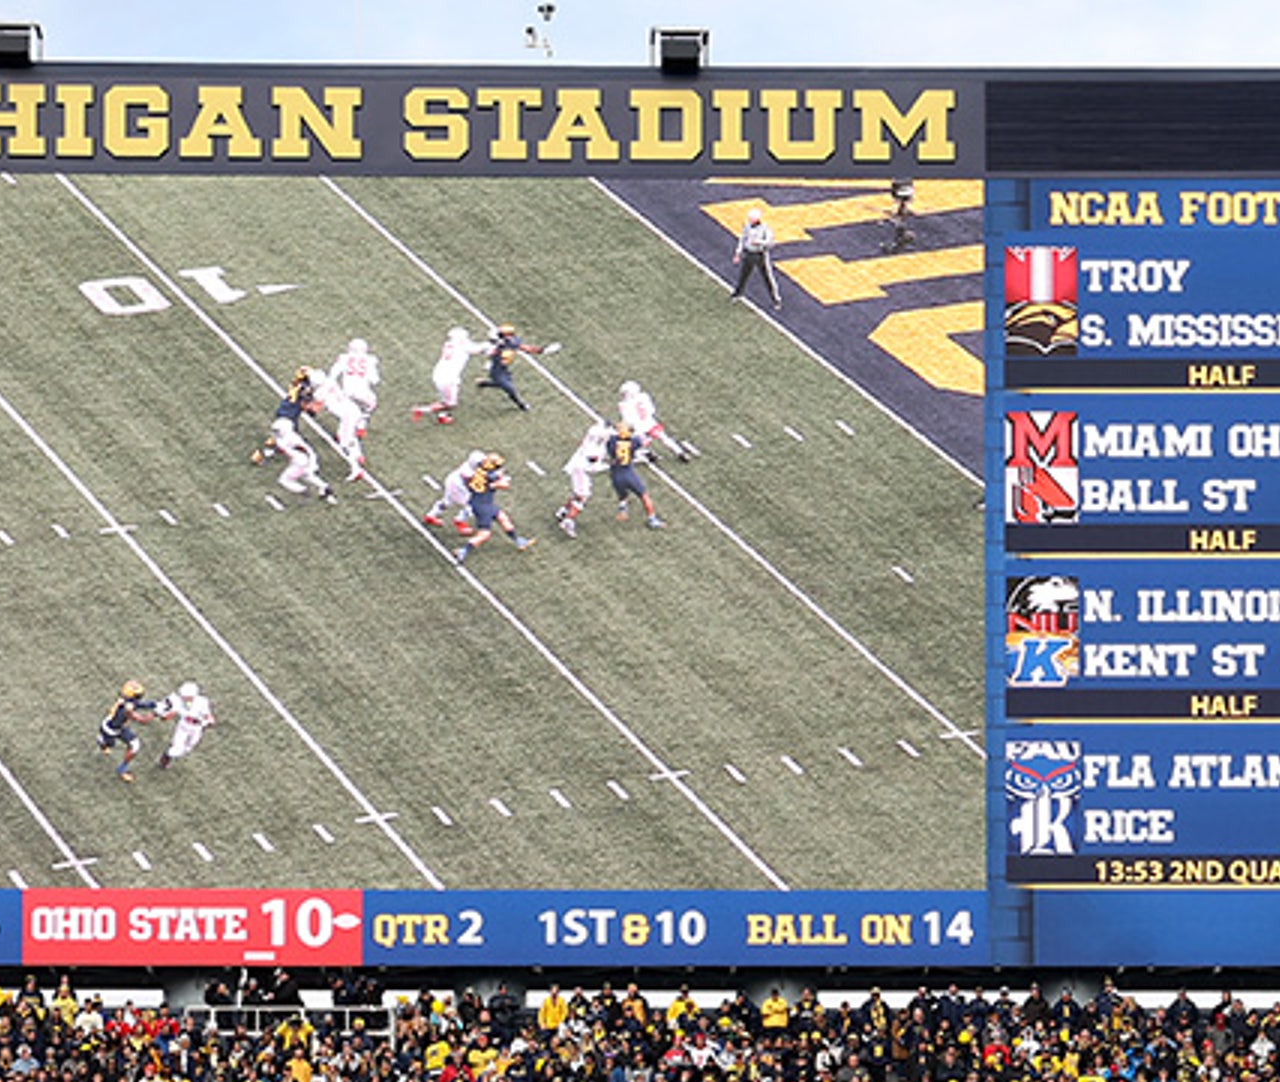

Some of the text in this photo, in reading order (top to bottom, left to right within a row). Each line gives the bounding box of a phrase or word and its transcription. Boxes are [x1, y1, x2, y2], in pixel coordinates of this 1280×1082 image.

[403, 86, 956, 161] STADIUM
[1048, 191, 1162, 226] NCAA
[1081, 260, 1191, 293] TROY
[1081, 313, 1113, 347] S.
[1188, 364, 1256, 387] HALF
[1006, 410, 1078, 468] M
[1083, 425, 1212, 457] MIAMI
[1081, 479, 1187, 512] BALL
[1203, 479, 1256, 512] ST
[1189, 530, 1257, 552] HALF
[1083, 588, 1122, 621] N.
[1083, 644, 1196, 677] KENT
[1211, 644, 1266, 677] ST
[1190, 695, 1259, 717] HALF
[1083, 755, 1154, 788] FLA
[1083, 809, 1175, 843] RICE
[1095, 860, 1165, 882] 13:53
[1168, 860, 1224, 882] 2ND
[31, 899, 333, 946] OHIO STATE 10
[372, 911, 484, 948] QTR 2
[746, 911, 974, 946] BALL ON 14
